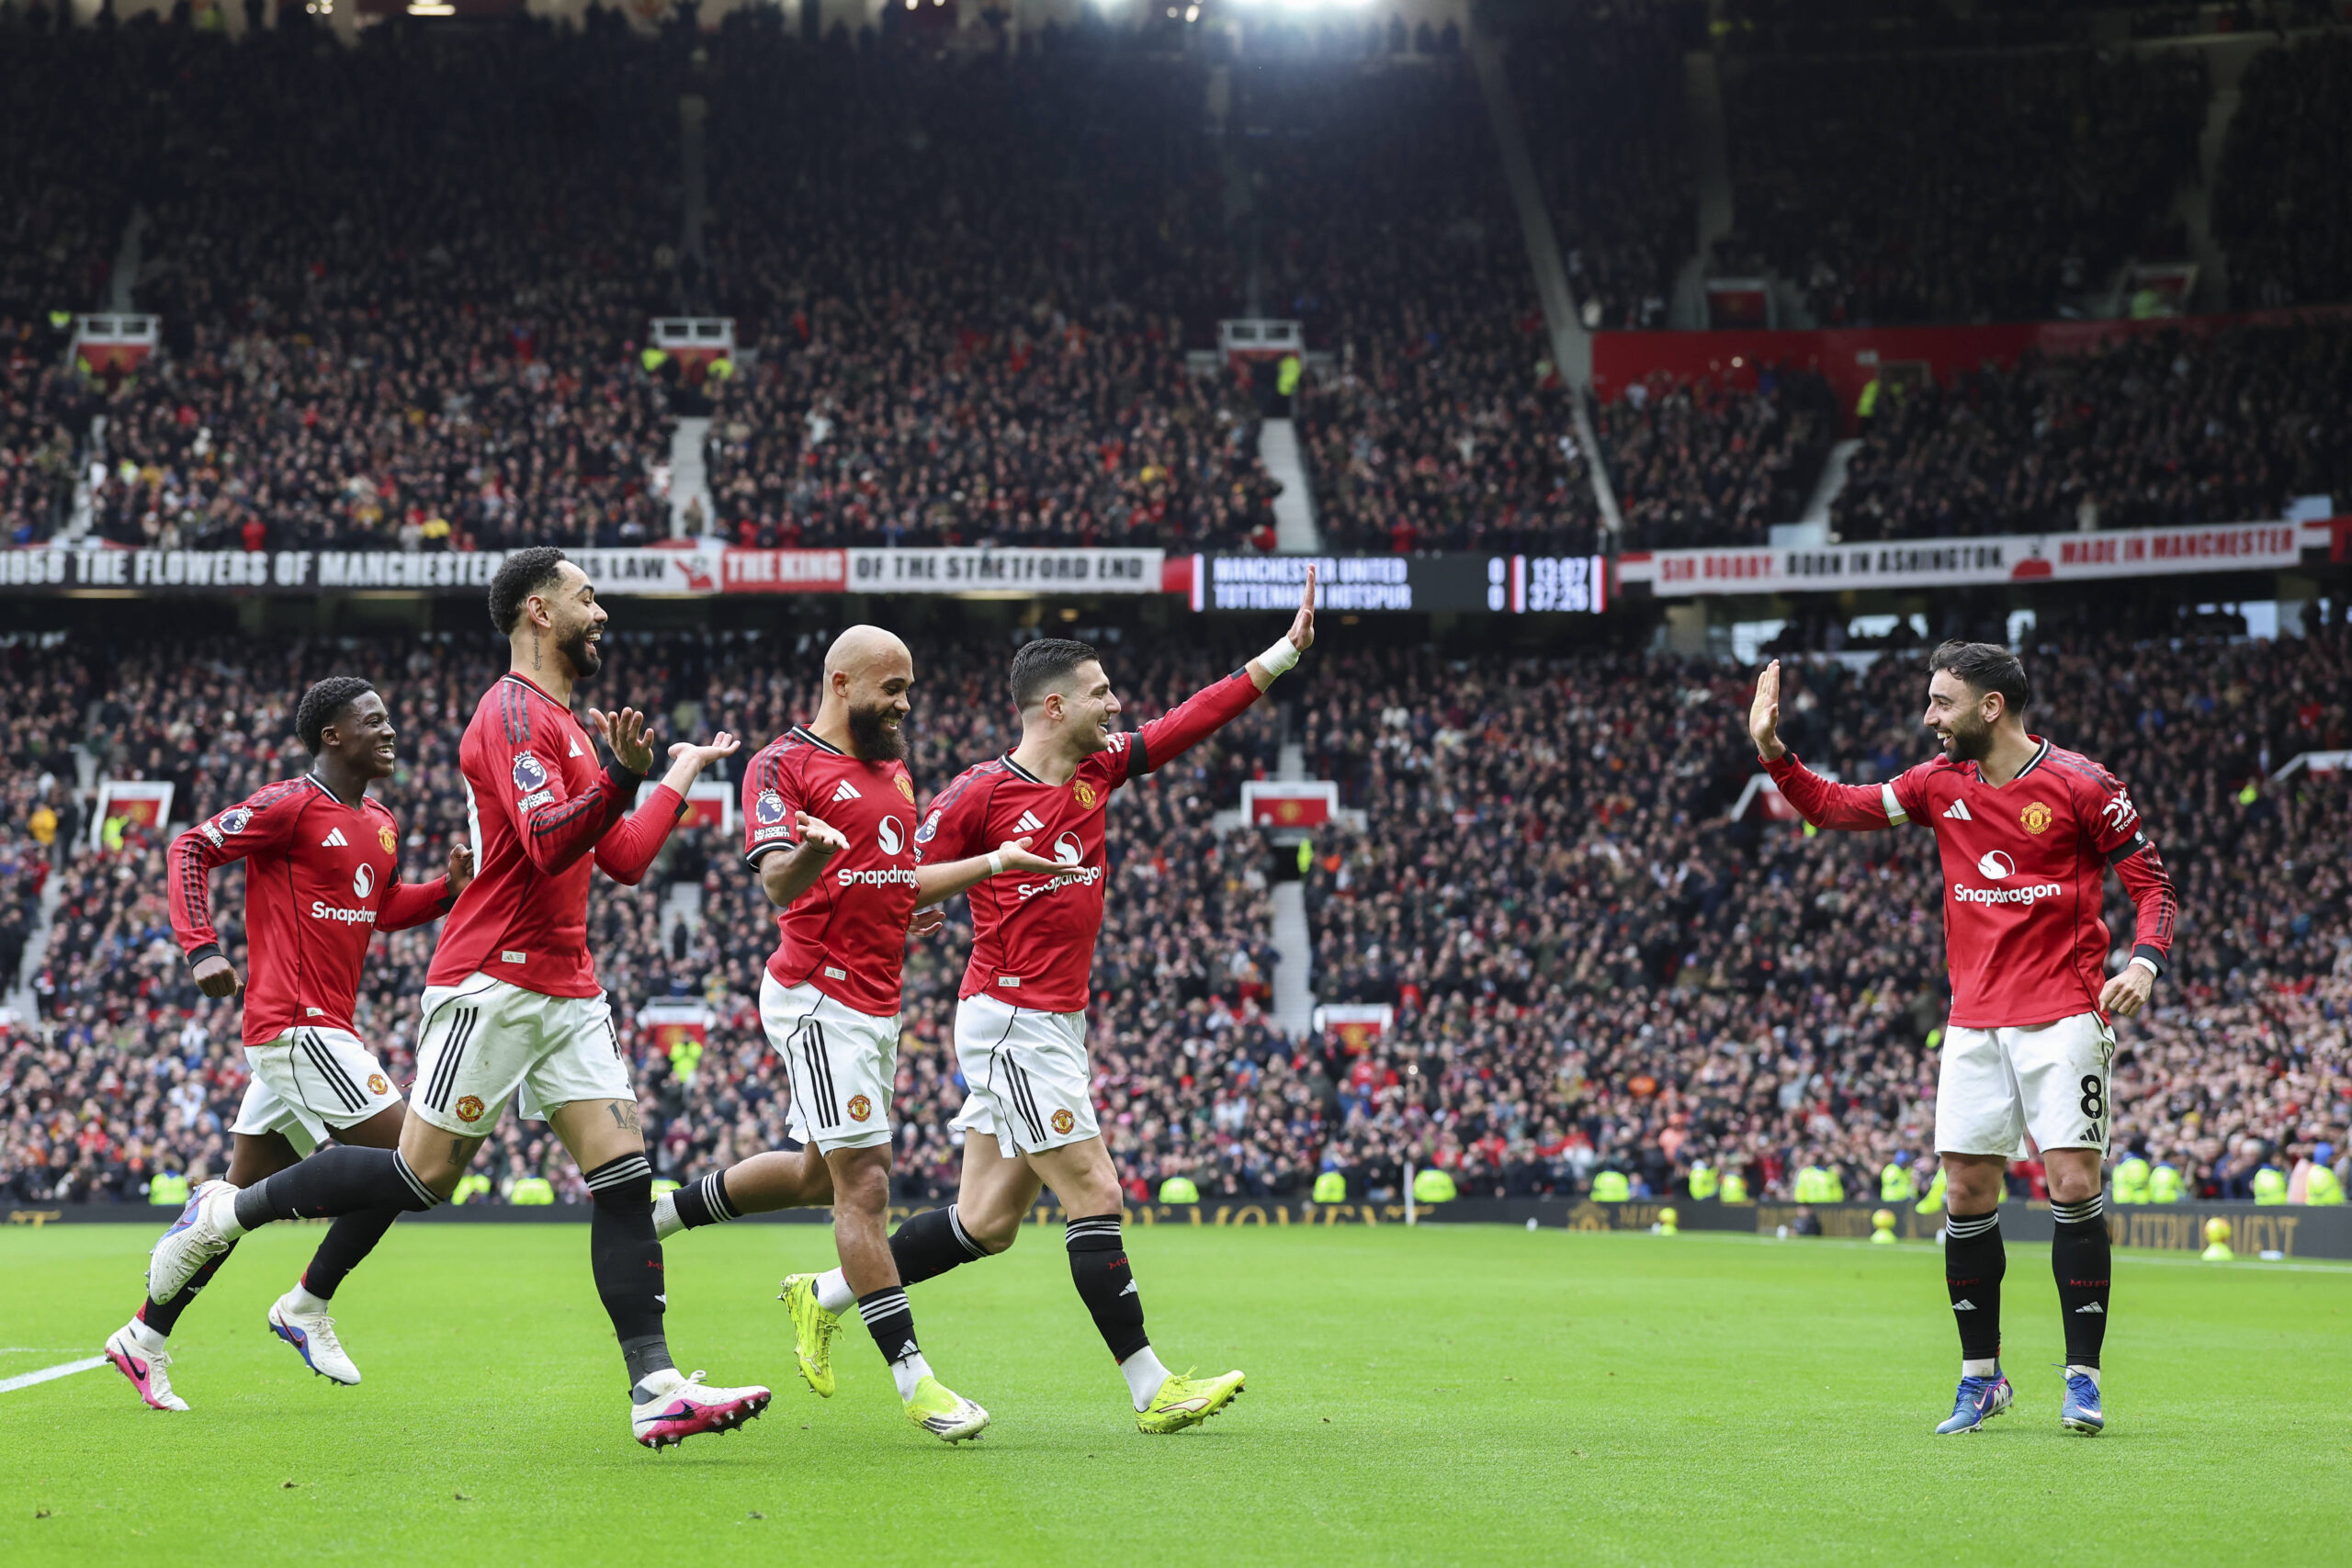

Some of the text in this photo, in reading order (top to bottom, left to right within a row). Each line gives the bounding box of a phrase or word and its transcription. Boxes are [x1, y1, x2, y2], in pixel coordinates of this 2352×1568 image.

[2123, 536, 2145, 561] IN
[2151, 526, 2295, 558] MANCHESTER
[74, 551, 128, 585] THE
[135, 551, 267, 586] FLOWERS
[275, 551, 312, 586] OF
[318, 551, 504, 586] MANCHESTER
[610, 557, 665, 580] LAW
[726, 554, 843, 582] THE KING
[856, 557, 1143, 579] OF THE STRETFORD END
[1214, 583, 1325, 609] TOTTENHM
[1954, 883, 2061, 908] Snapdragon
[2080, 1074, 2103, 1120] 8
